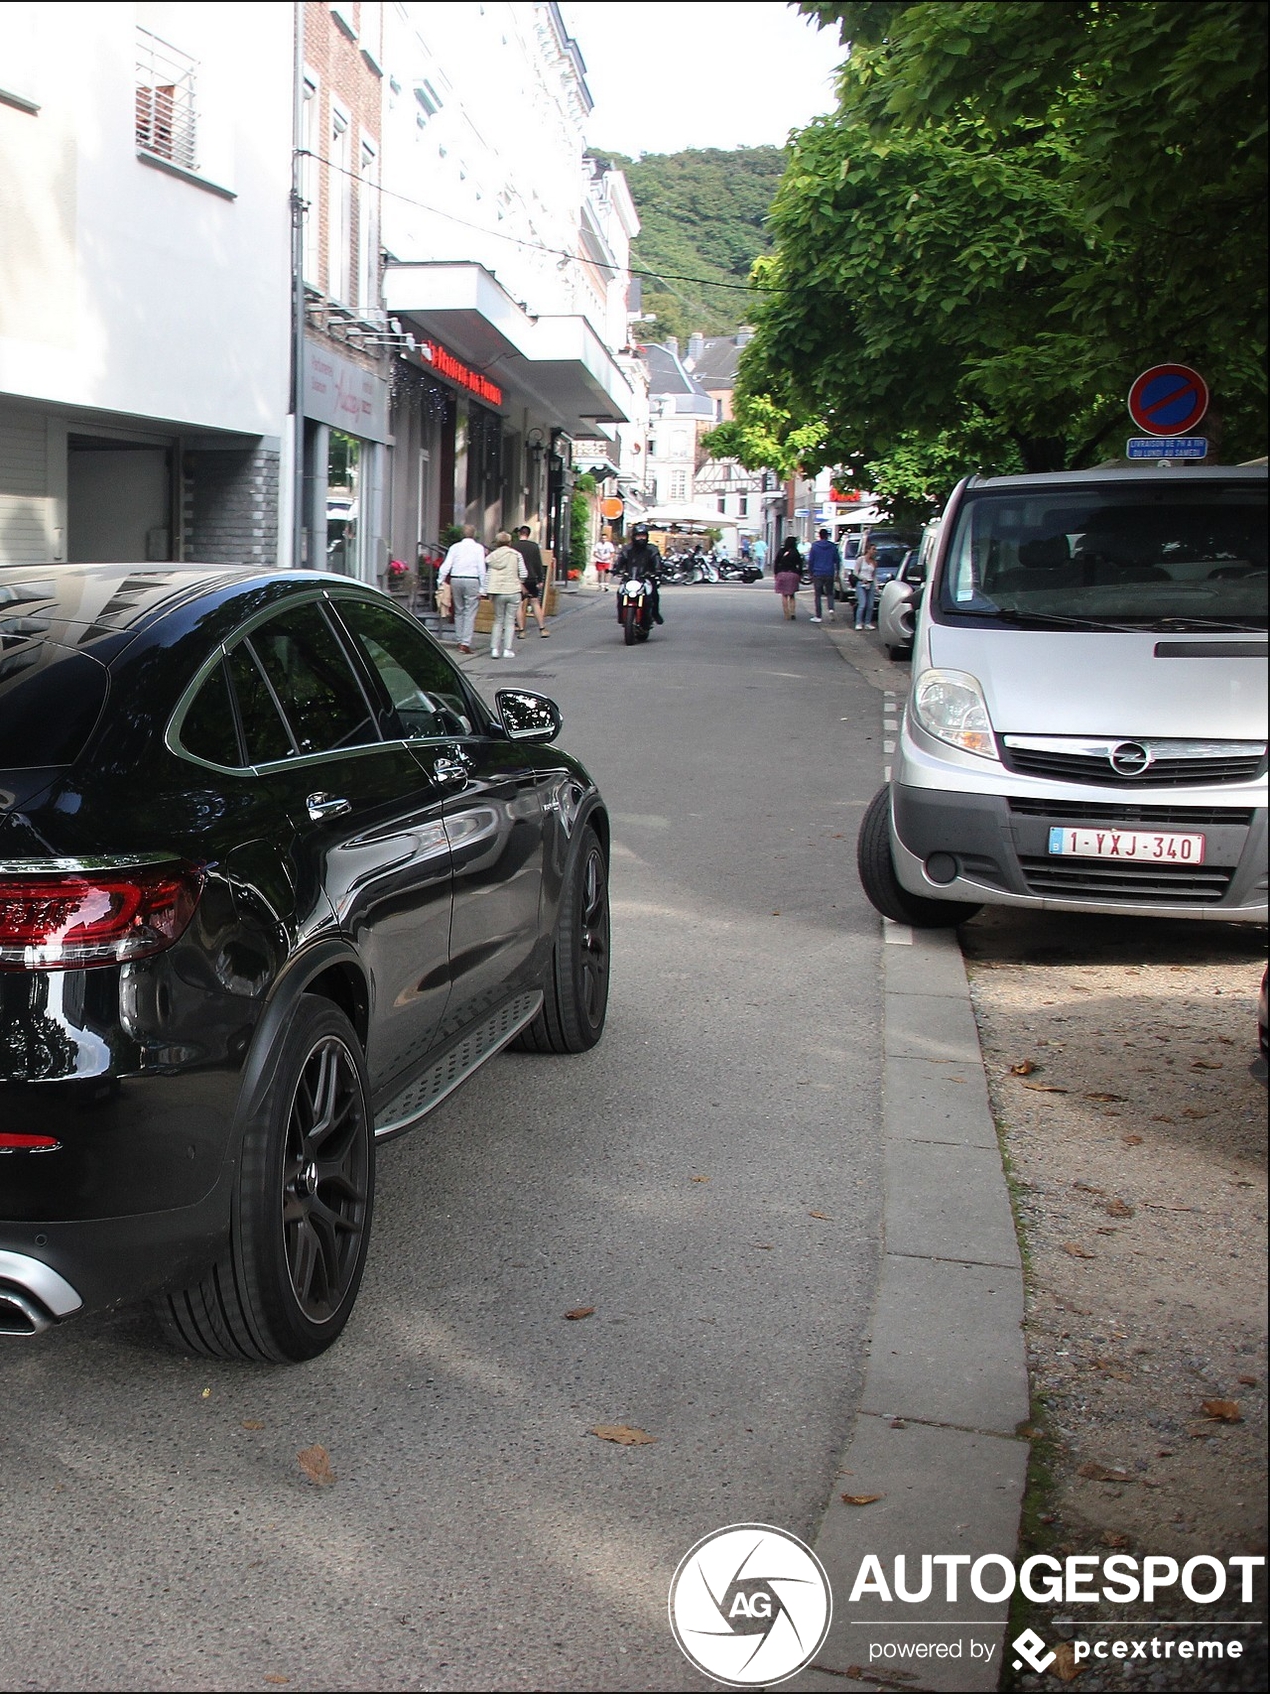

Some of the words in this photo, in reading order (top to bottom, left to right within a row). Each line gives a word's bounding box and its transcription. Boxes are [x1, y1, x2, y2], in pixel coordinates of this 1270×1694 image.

[1130, 440, 1164, 448] LIVRAISON
[1165, 439, 1175, 447] DE
[1143, 449, 1163, 457] LUNDI
[1175, 449, 1201, 457] SAMEDI
[1070, 832, 1192, 860] 1-YXJ-340
